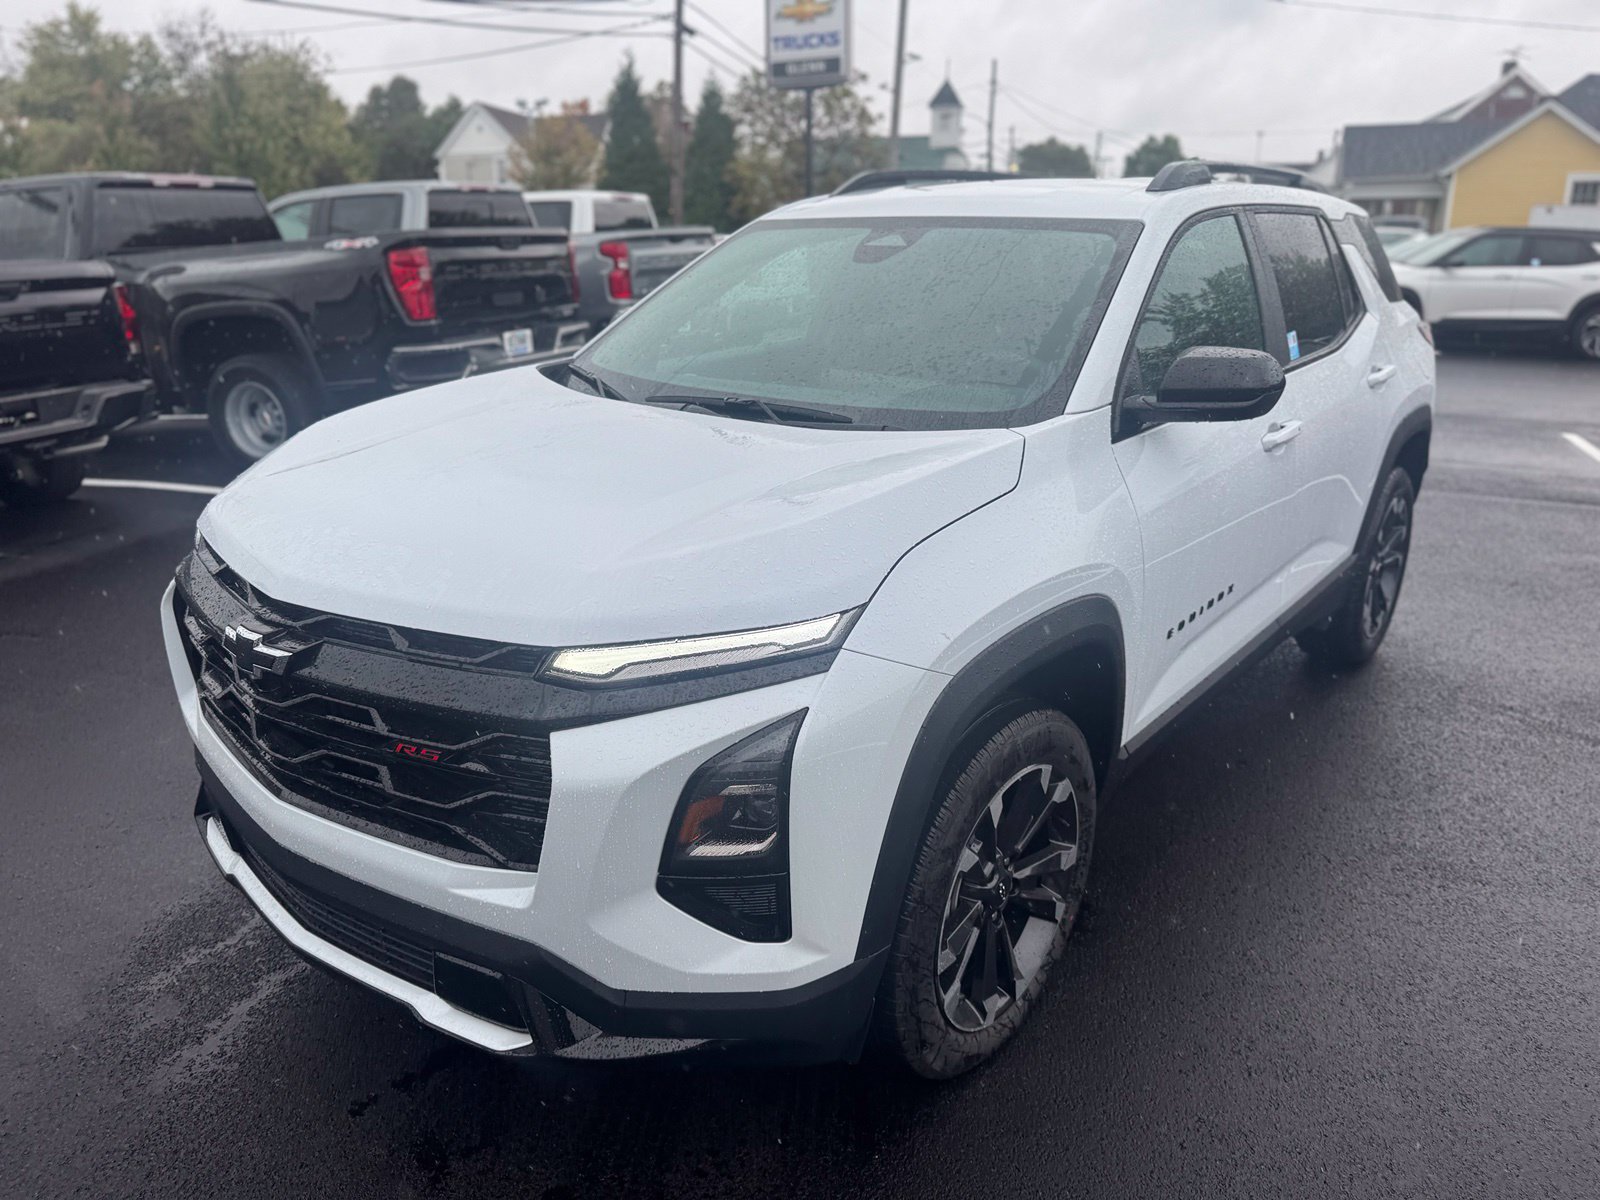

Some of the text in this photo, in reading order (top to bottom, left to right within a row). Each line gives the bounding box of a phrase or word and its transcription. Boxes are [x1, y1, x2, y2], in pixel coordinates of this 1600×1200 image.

[773, 31, 840, 50] TRUCKS
[1166, 583, 1234, 640] EQUINOX
[395, 743, 442, 761] RS
